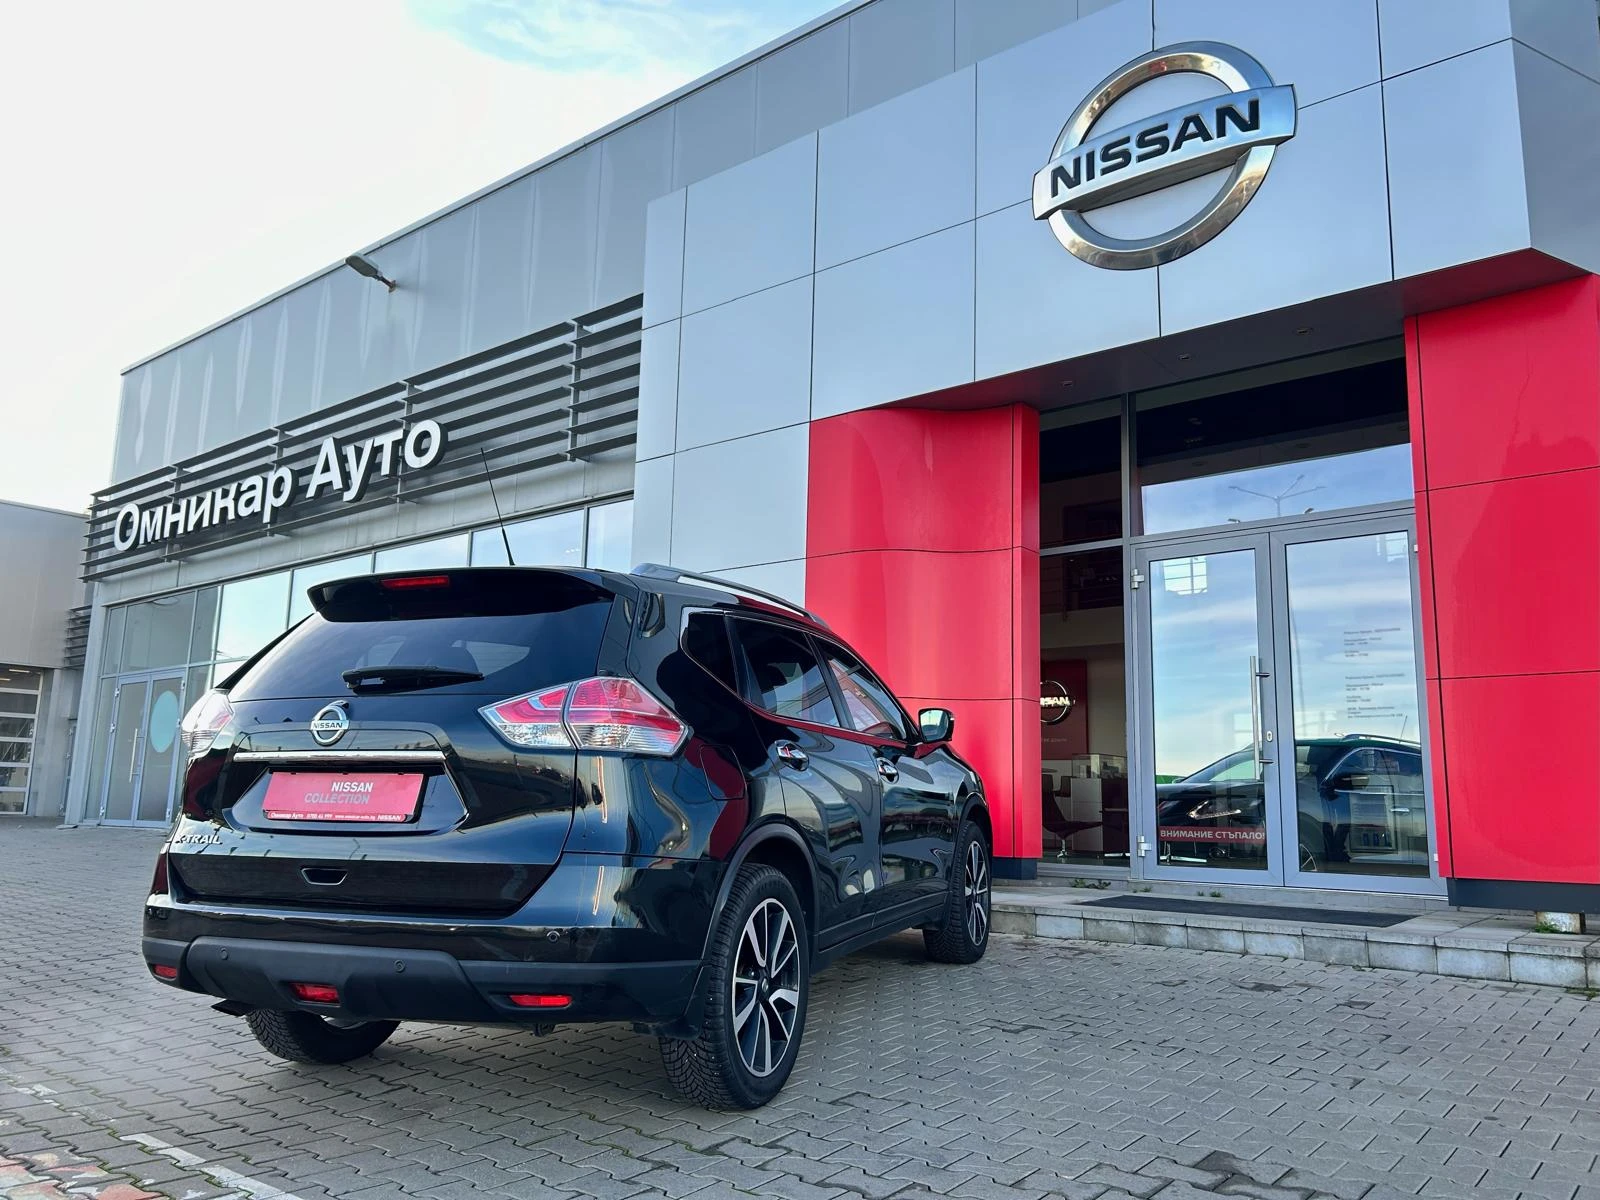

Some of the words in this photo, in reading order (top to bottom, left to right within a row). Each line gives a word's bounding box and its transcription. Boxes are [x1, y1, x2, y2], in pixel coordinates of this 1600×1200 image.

[1050, 99, 1260, 199] NISSAN
[113, 465, 297, 552] Омникар
[305, 419, 446, 502] Ауто
[312, 721, 344, 730] NISSAN
[331, 782, 373, 793] NISSAN
[304, 792, 370, 804] COLLECTION
[1160, 829, 1213, 839] ВНИМАНИЕ
[1215, 831, 1266, 840] СТЪПАЛО!
